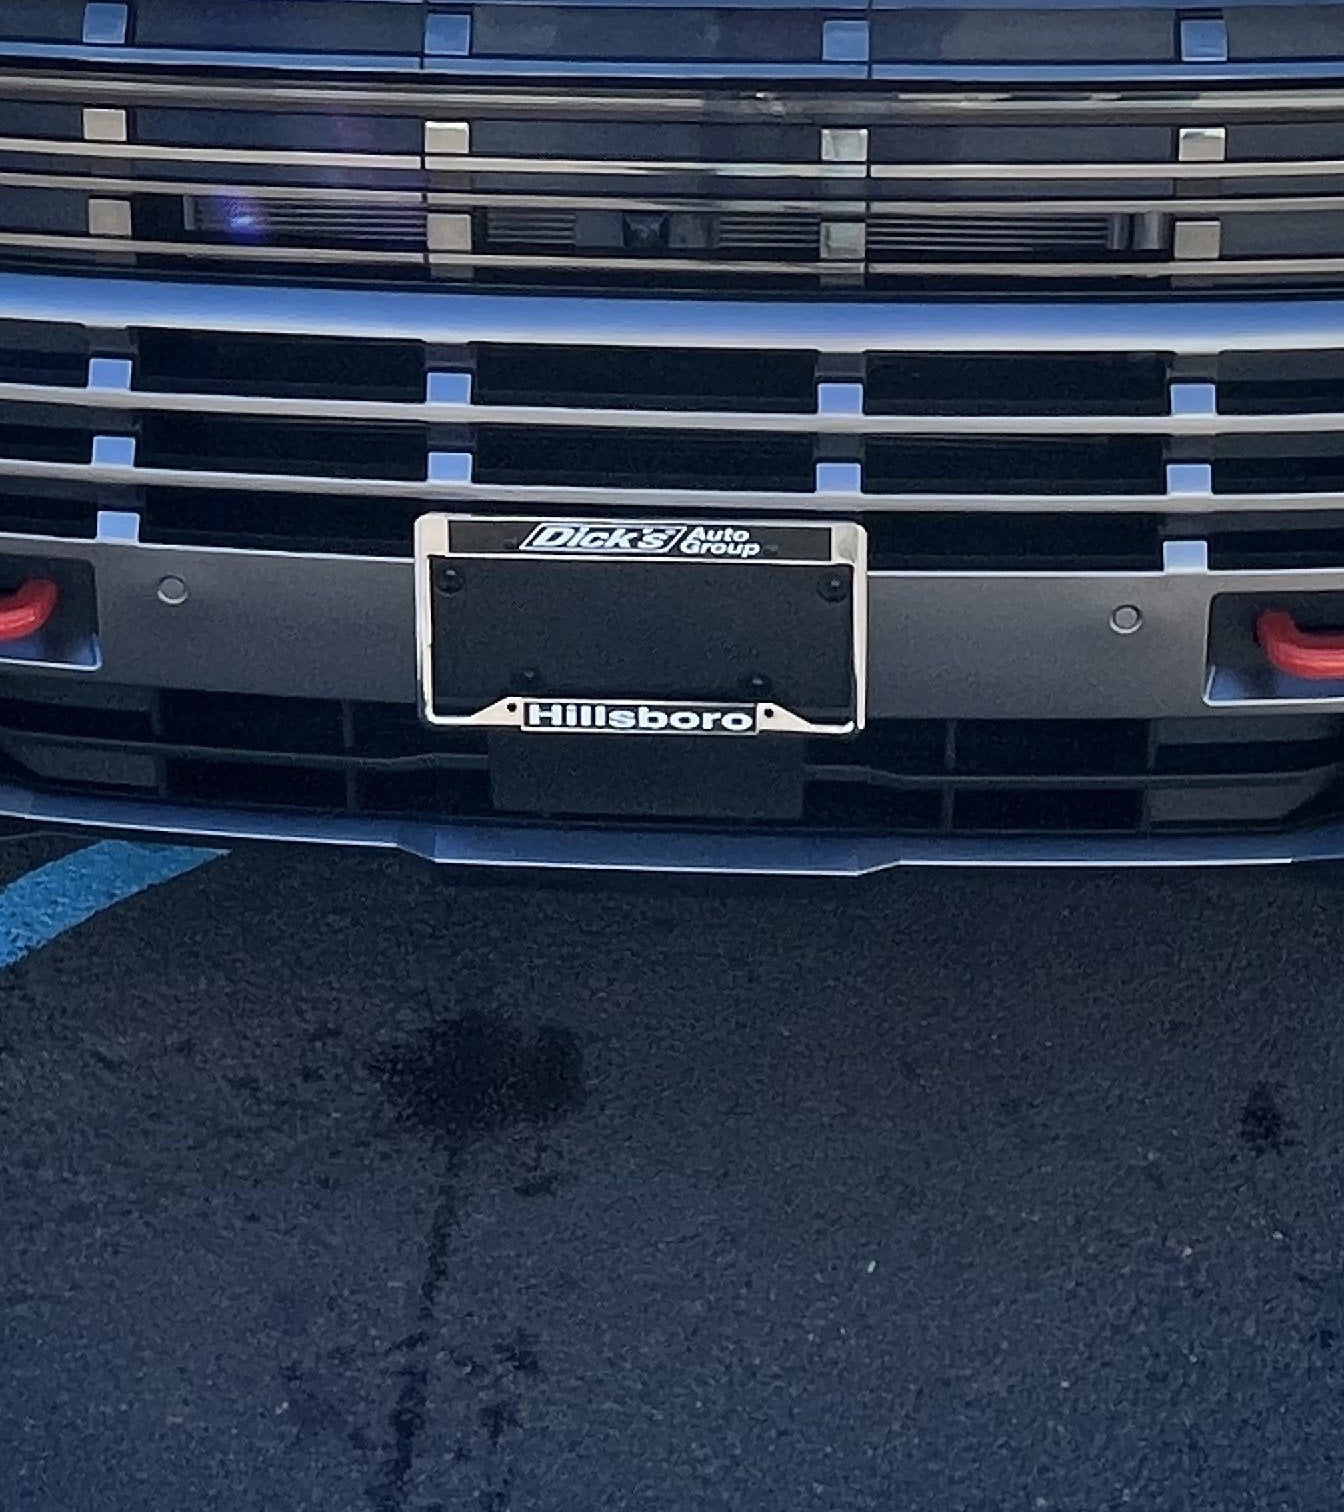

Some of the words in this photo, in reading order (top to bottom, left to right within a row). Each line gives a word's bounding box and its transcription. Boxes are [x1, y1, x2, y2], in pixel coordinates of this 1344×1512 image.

[686, 526, 750, 542] Auto
[680, 541, 760, 558] Group
[528, 704, 753, 731] Hillsboro
